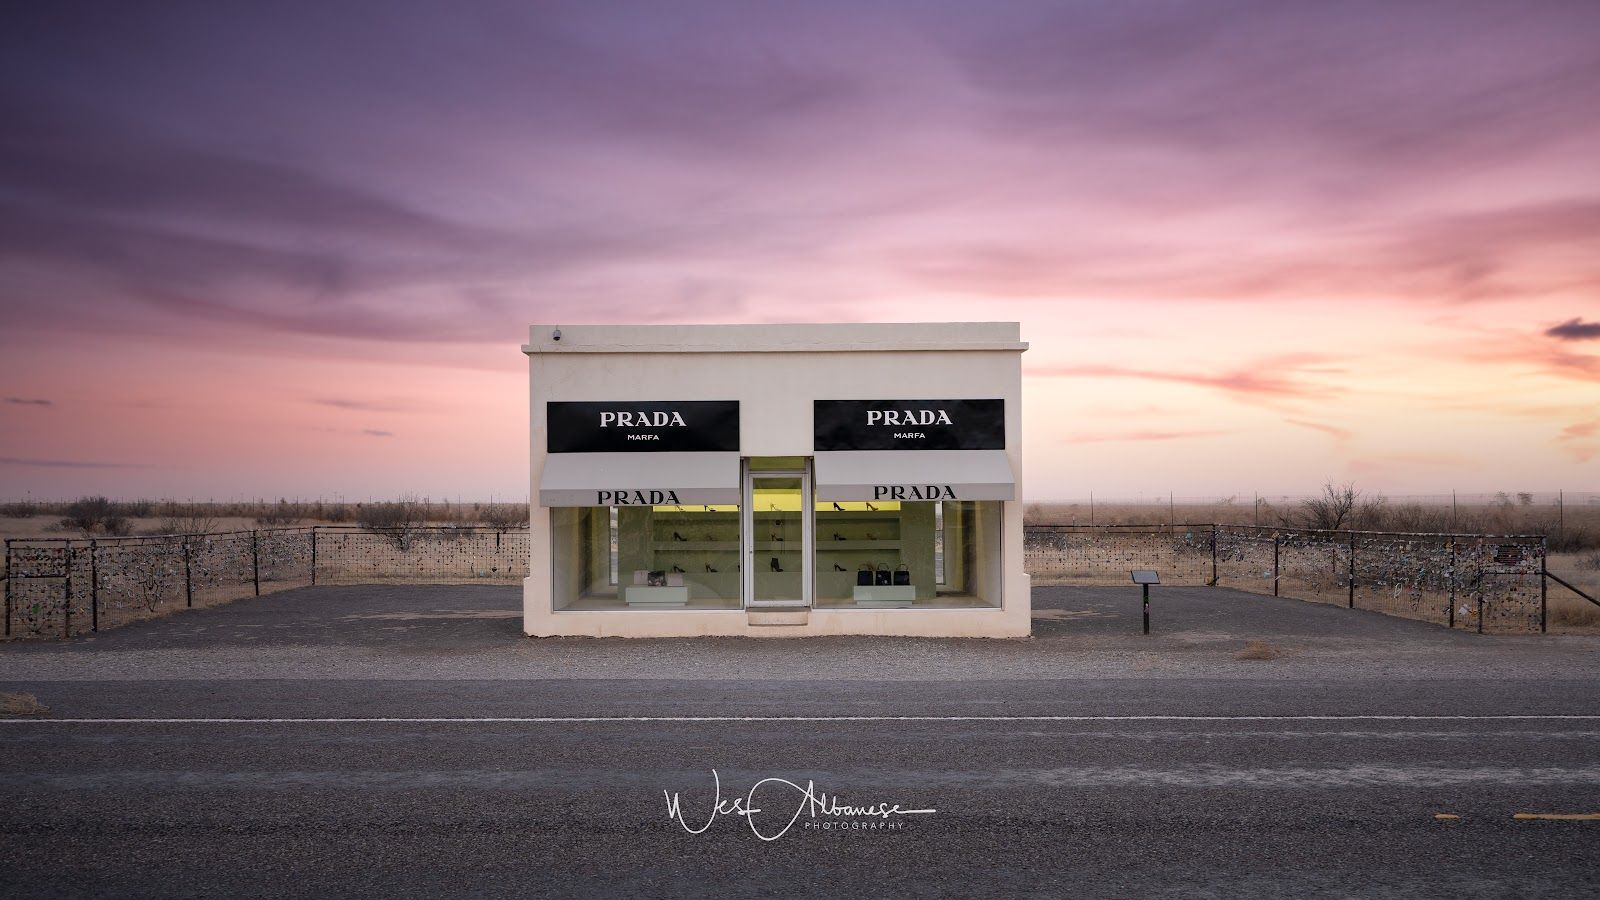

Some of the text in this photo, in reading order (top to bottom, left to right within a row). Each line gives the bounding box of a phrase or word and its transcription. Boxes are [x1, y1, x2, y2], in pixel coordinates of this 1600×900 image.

[599, 411, 687, 428] PRADA
[866, 409, 953, 426] PRADA
[597, 490, 681, 505] PRADA
[873, 485, 958, 500] PRADA
